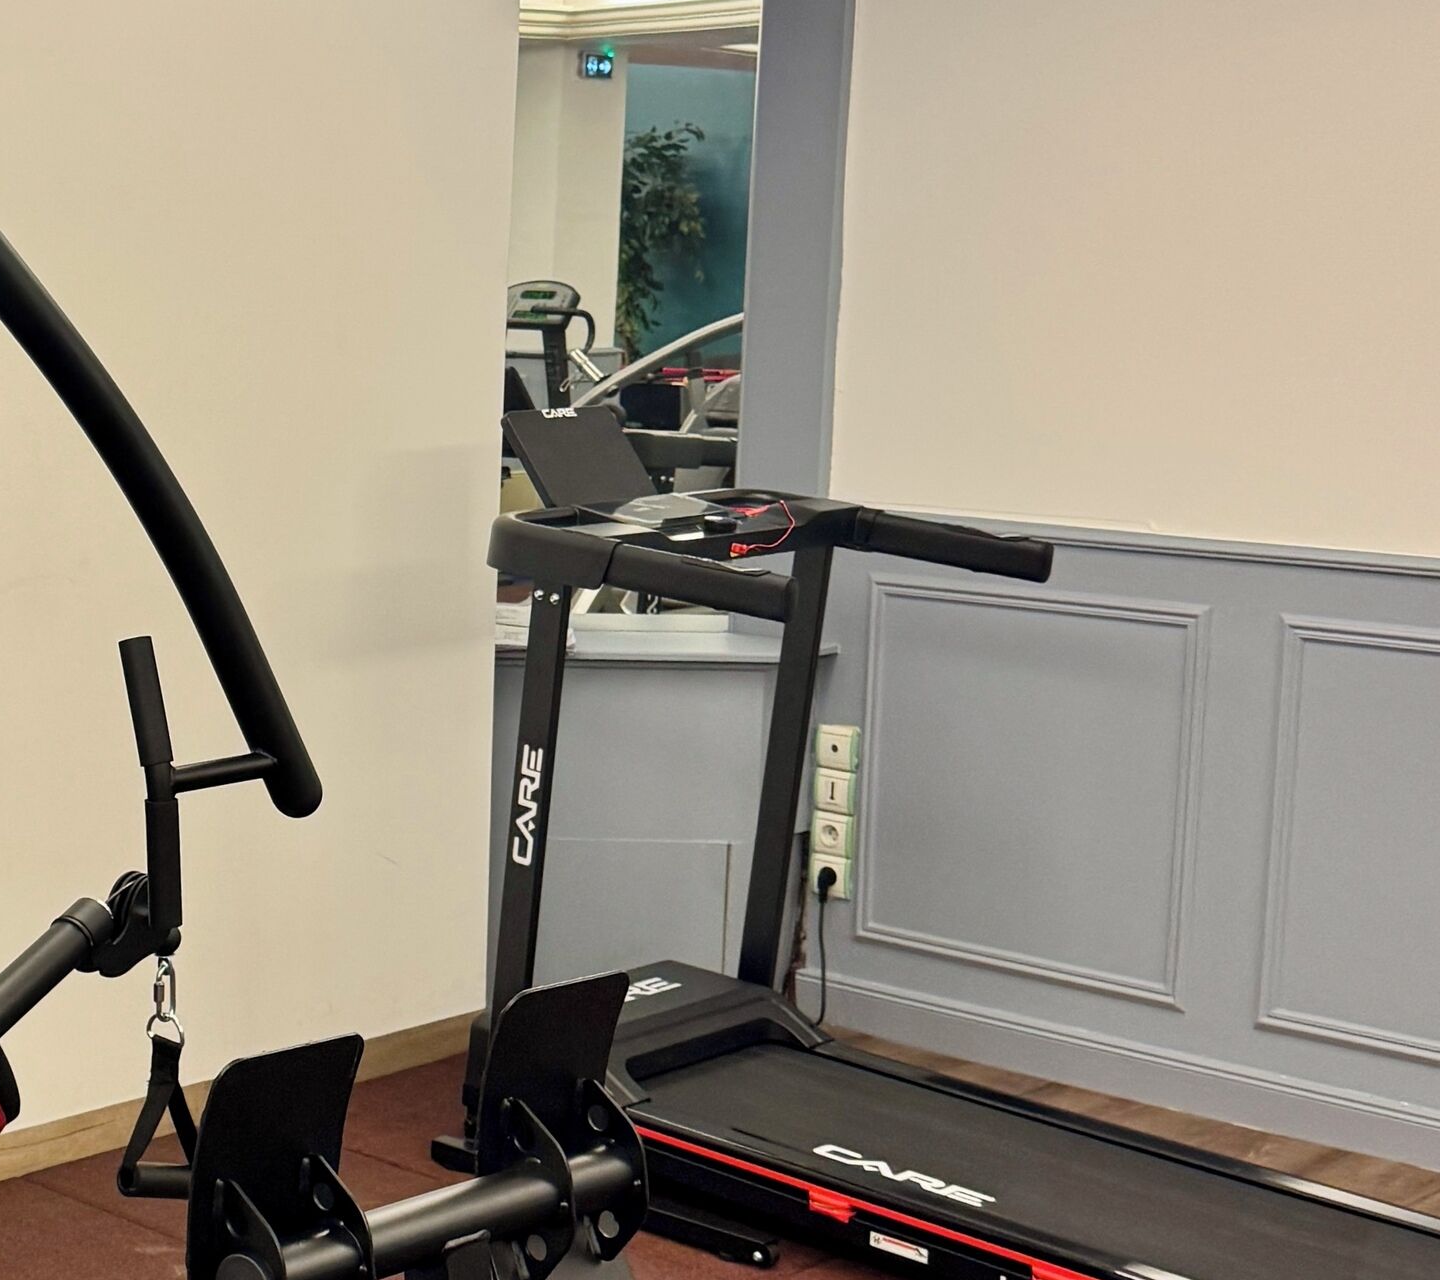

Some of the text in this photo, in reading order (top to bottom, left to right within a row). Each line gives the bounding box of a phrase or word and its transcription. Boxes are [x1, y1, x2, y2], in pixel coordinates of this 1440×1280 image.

[541, 407, 578, 419] CARE
[512, 743, 544, 866] CARE
[812, 1144, 997, 1207] CARE
